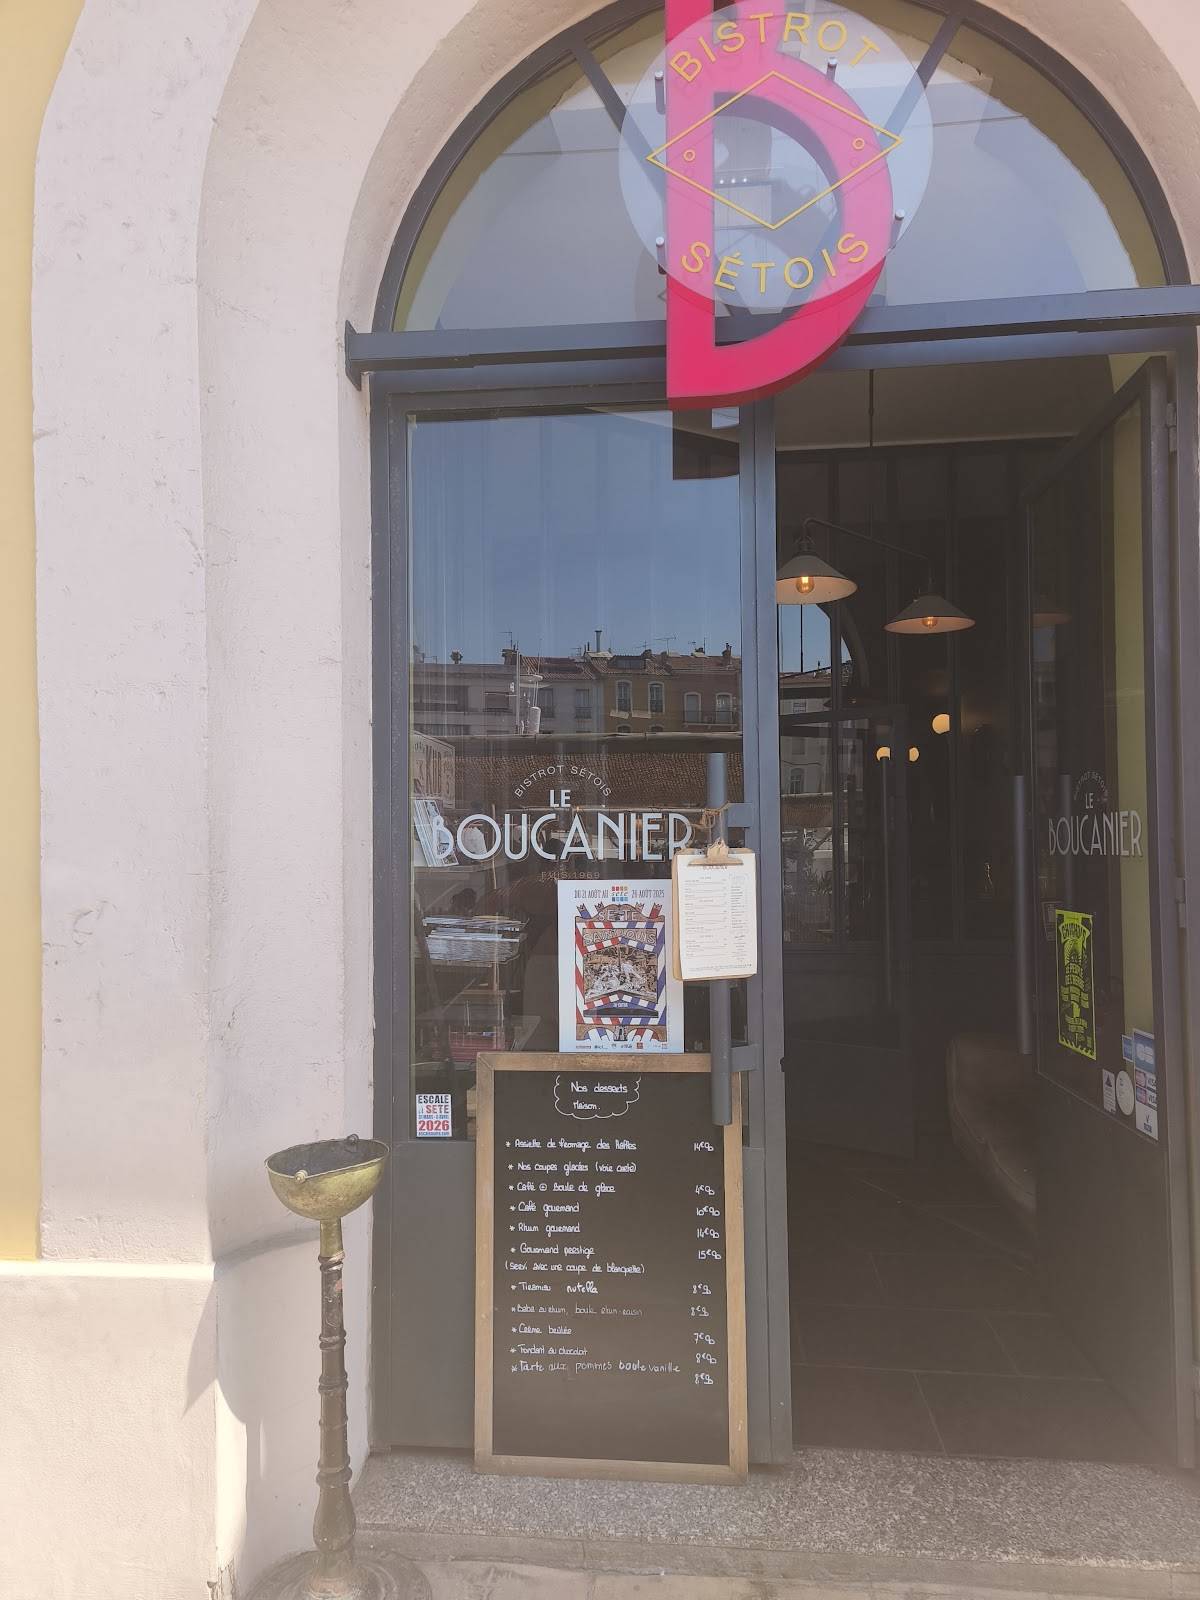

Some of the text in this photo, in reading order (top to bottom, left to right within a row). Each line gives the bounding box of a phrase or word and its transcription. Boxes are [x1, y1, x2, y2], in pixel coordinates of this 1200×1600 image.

[670, 12, 881, 83] BISTROT
[680, 232, 870, 294] SÉTOIS
[514, 765, 612, 798] BISTROT SÉTOIS
[549, 789, 571, 807] LE
[1085, 792, 1094, 809] LE
[432, 813, 693, 861] BOUCANIER
[1048, 810, 1143, 857] BOUCANIER
[570, 1081, 628, 1093] Nos desserts
[418, 1095, 449, 1104] ESCALE
[418, 1120, 449, 1131] 2026
[514, 1139, 542, 1149] Assiette
[547, 1138, 556, 1148] de
[596, 1139, 611, 1150] des
[517, 1162, 532, 1172] Nos
[534, 1164, 558, 1175] coupes
[517, 1182, 536, 1192] Café
[578, 1182, 589, 1192] de
[595, 1183, 616, 1196] glace
[518, 1202, 536, 1213] Café
[543, 1202, 580, 1217] gourmand
[518, 1223, 539, 1232] Rhum
[545, 1223, 581, 1237] gourmand
[520, 1242, 559, 1254] Gourmand
[563, 1244, 596, 1259] prestige
[532, 1263, 548, 1272] avec
[550, 1264, 563, 1272] une
[566, 1264, 587, 1275] coupe
[592, 1263, 602, 1273] de
[566, 1281, 599, 1294] nutella
[517, 1345, 545, 1354] Fondant
[548, 1347, 557, 1355] au
[558, 1346, 588, 1356] chocolat
[519, 1362, 545, 1372] Tarte
[548, 1363, 567, 1372] aux
[575, 1361, 613, 1374] pommes
[618, 1360, 646, 1371] boule
[649, 1362, 681, 1373] vanille
